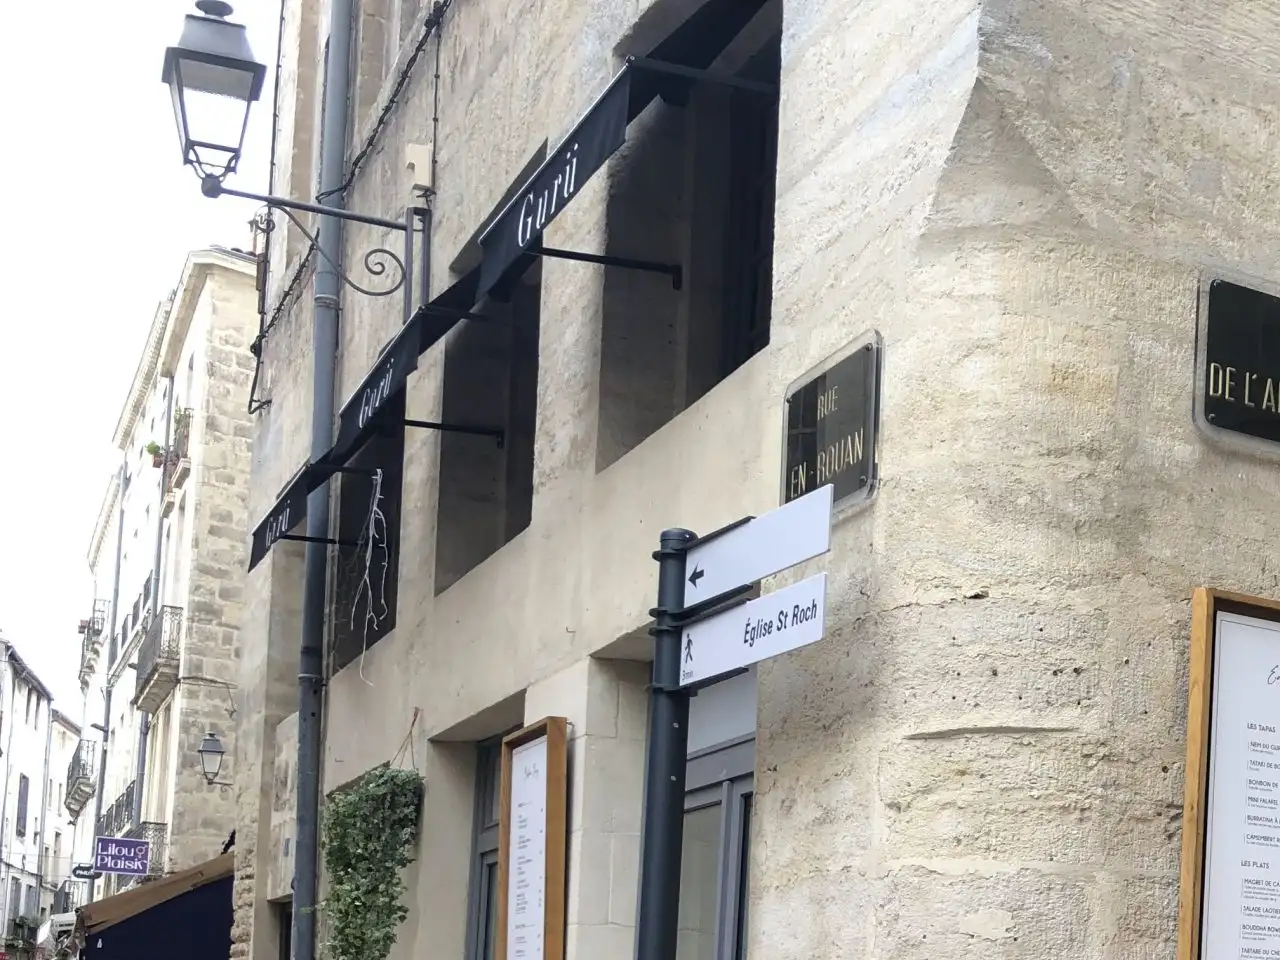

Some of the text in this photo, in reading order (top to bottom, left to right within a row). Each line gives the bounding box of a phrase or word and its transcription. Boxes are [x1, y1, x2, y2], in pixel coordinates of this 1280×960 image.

[518, 143, 578, 247] Gurü
[1209, 362, 1236, 401] DE
[817, 385, 838, 421] RUE
[743, 599, 817, 647] Église St Roch
[1247, 722, 1276, 733] LES TAPAS
[98, 842, 135, 857] Lilou
[97, 855, 148, 870] Plaisir
[1252, 861, 1270, 869] PLATS
